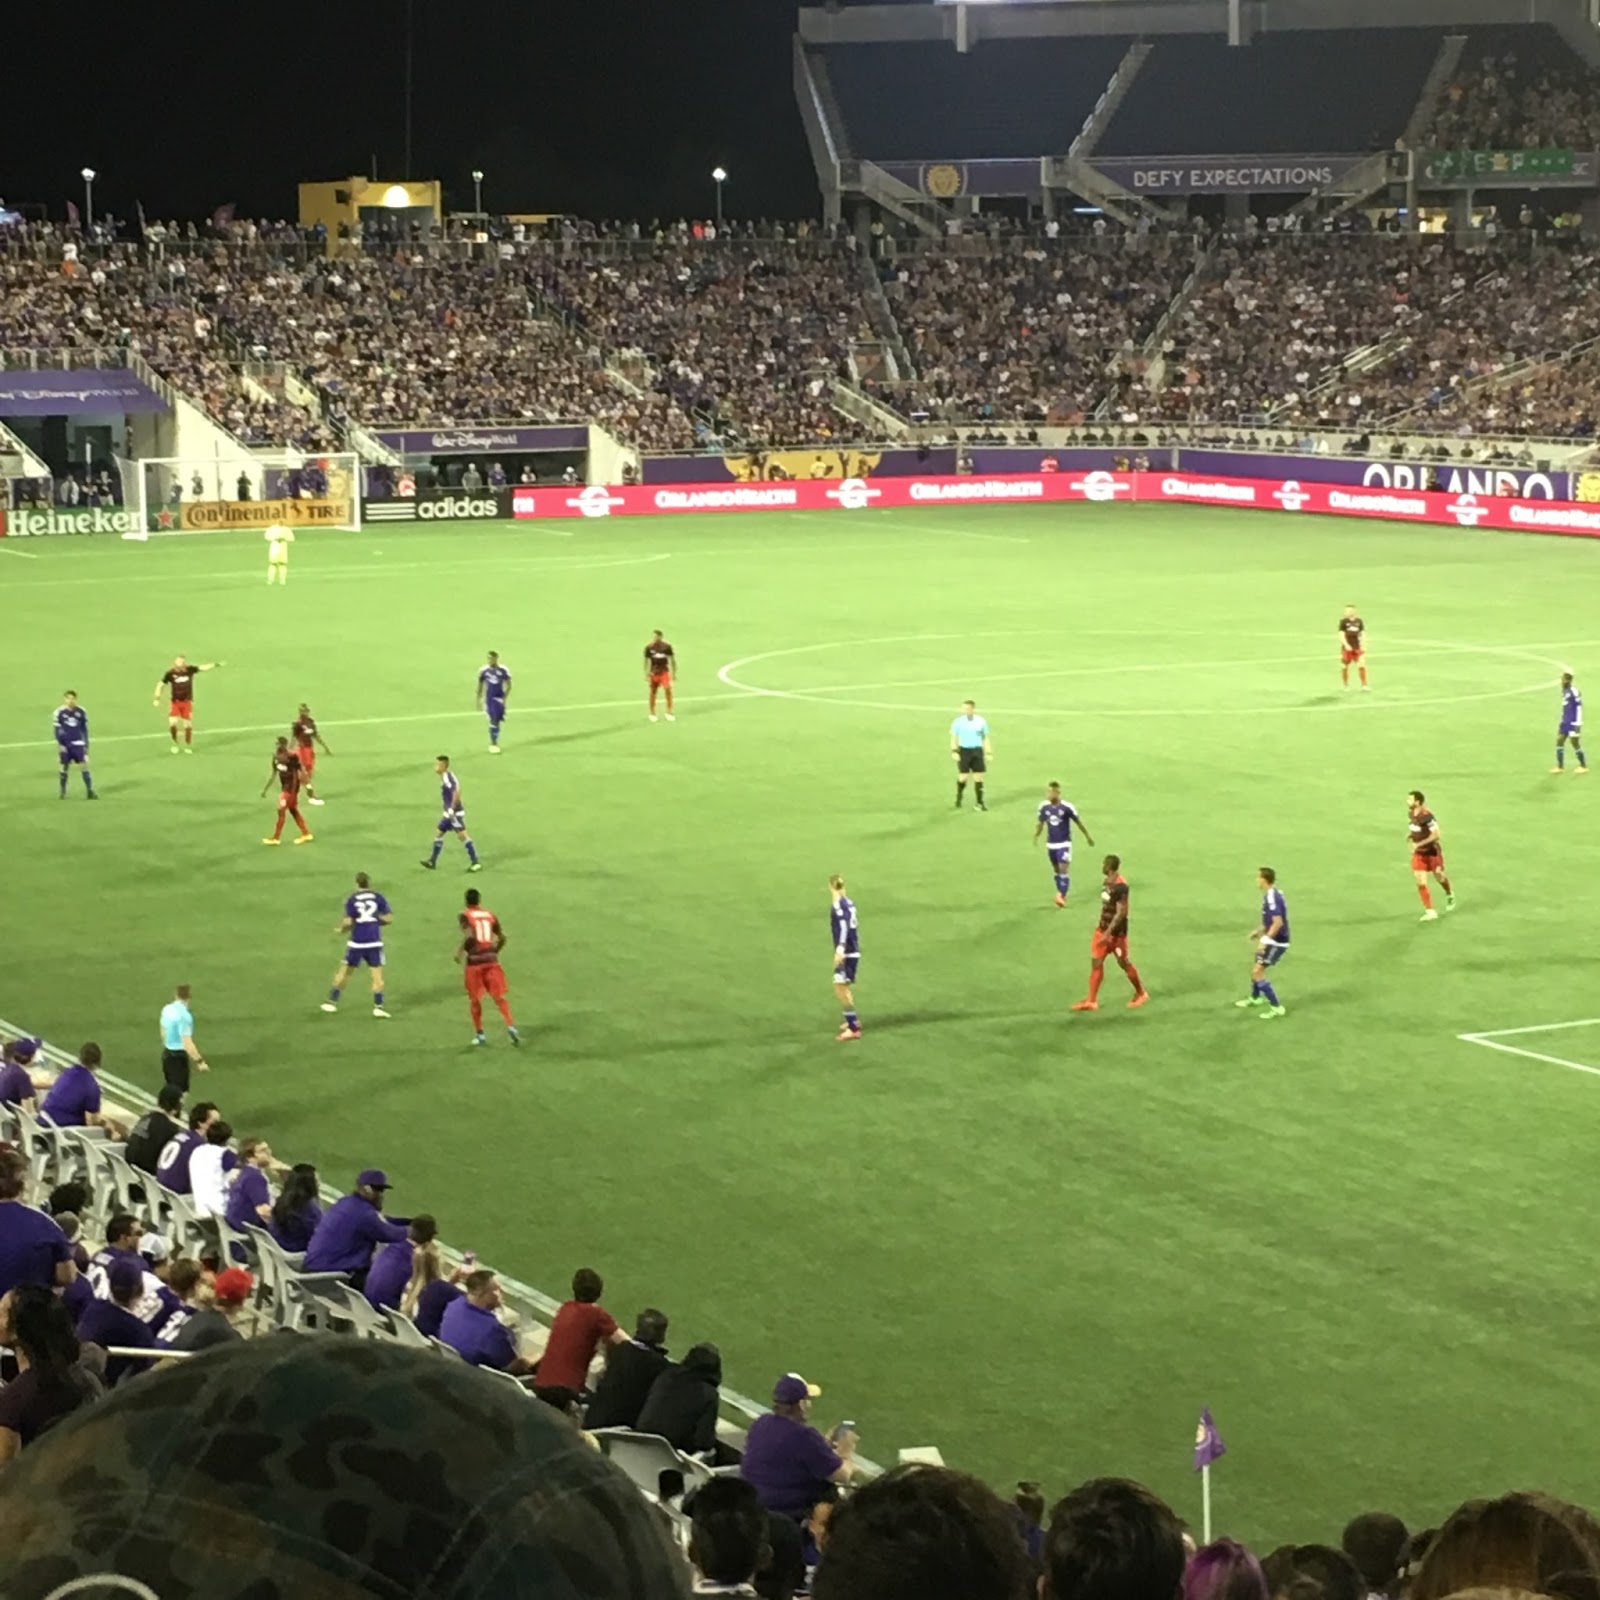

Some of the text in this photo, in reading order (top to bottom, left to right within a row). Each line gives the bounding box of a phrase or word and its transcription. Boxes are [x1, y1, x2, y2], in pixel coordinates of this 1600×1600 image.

[1133, 166, 1333, 187] DEFY EXPECTATIONS
[186, 503, 345, 527] Continental TIRE
[418, 497, 498, 518] adidas
[6, 507, 147, 536] Heineken
[353, 900, 378, 923] 32
[474, 919, 493, 943] 11
